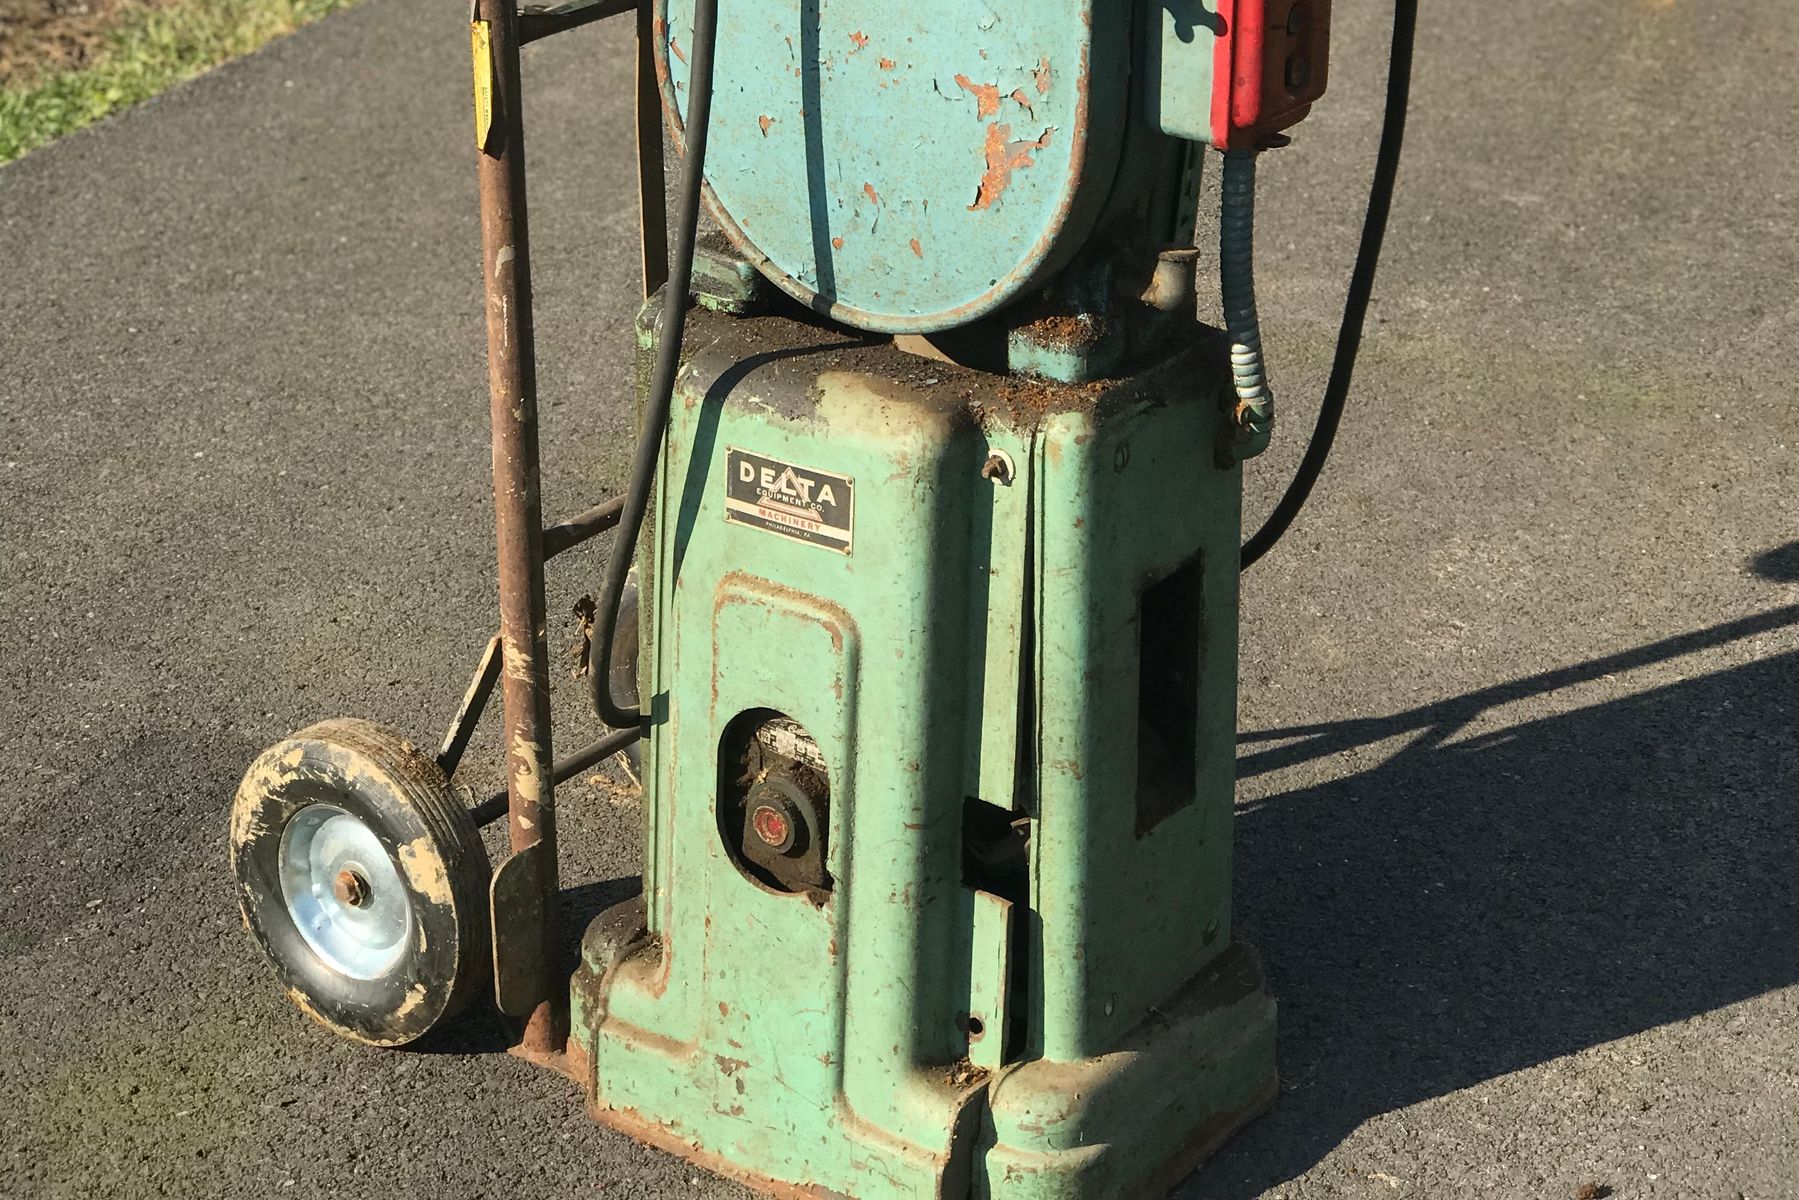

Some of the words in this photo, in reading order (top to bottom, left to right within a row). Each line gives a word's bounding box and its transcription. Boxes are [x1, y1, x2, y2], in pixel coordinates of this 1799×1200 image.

[739, 460, 837, 507] DELTA
[756, 487, 807, 507] EQUIPMENT
[810, 502, 825, 513] CO.
[758, 508, 821, 532] MACHINERY
